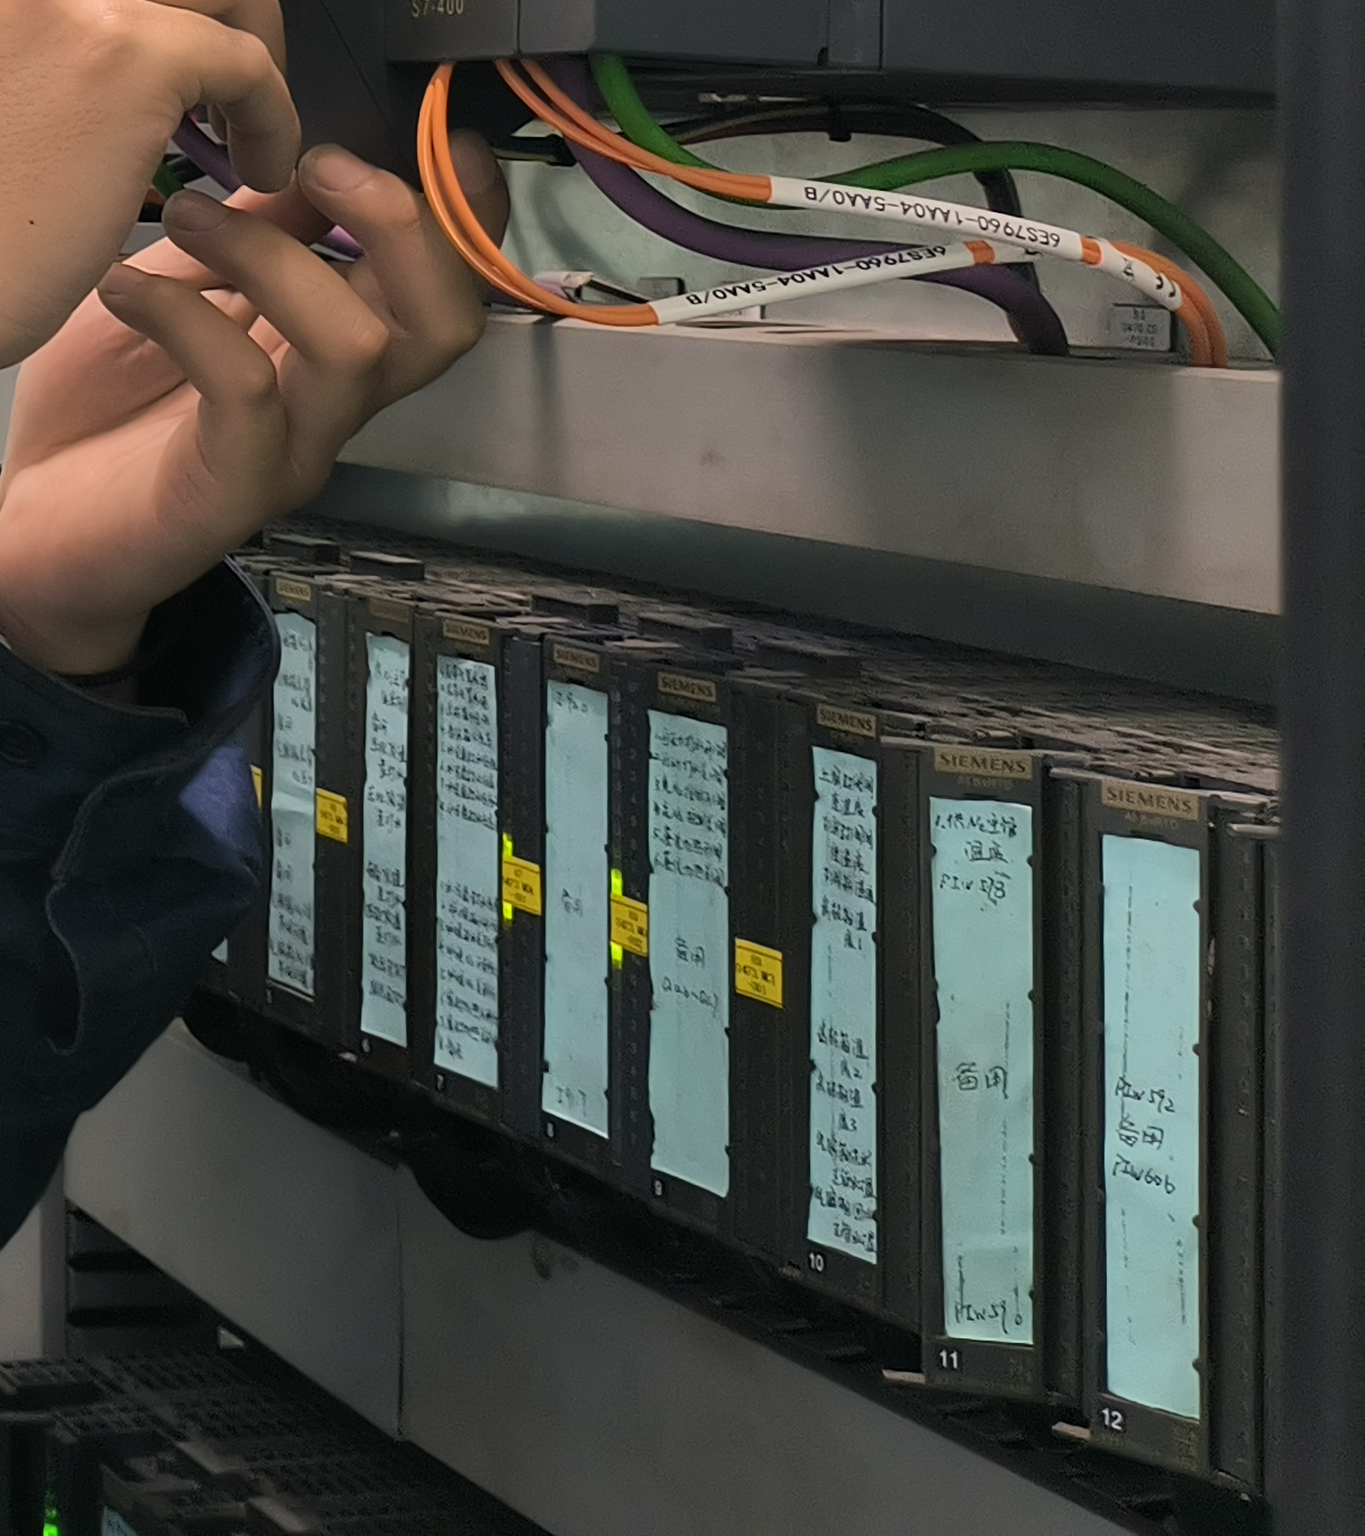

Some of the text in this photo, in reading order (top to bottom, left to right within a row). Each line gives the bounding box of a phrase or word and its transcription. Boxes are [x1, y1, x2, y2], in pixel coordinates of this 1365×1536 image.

[804, 185, 1062, 248] 6ES7960-1AA04-5AA0/B
[819, 708, 873, 732] SIEMENS
[939, 754, 1027, 773] SIEMENS
[1106, 789, 1193, 812] SIEMENS
[952, 1060, 1010, 1099] 备用
[809, 1252, 825, 1273] 10
[939, 1349, 958, 1369] 11
[1101, 1407, 1123, 1431] 12
